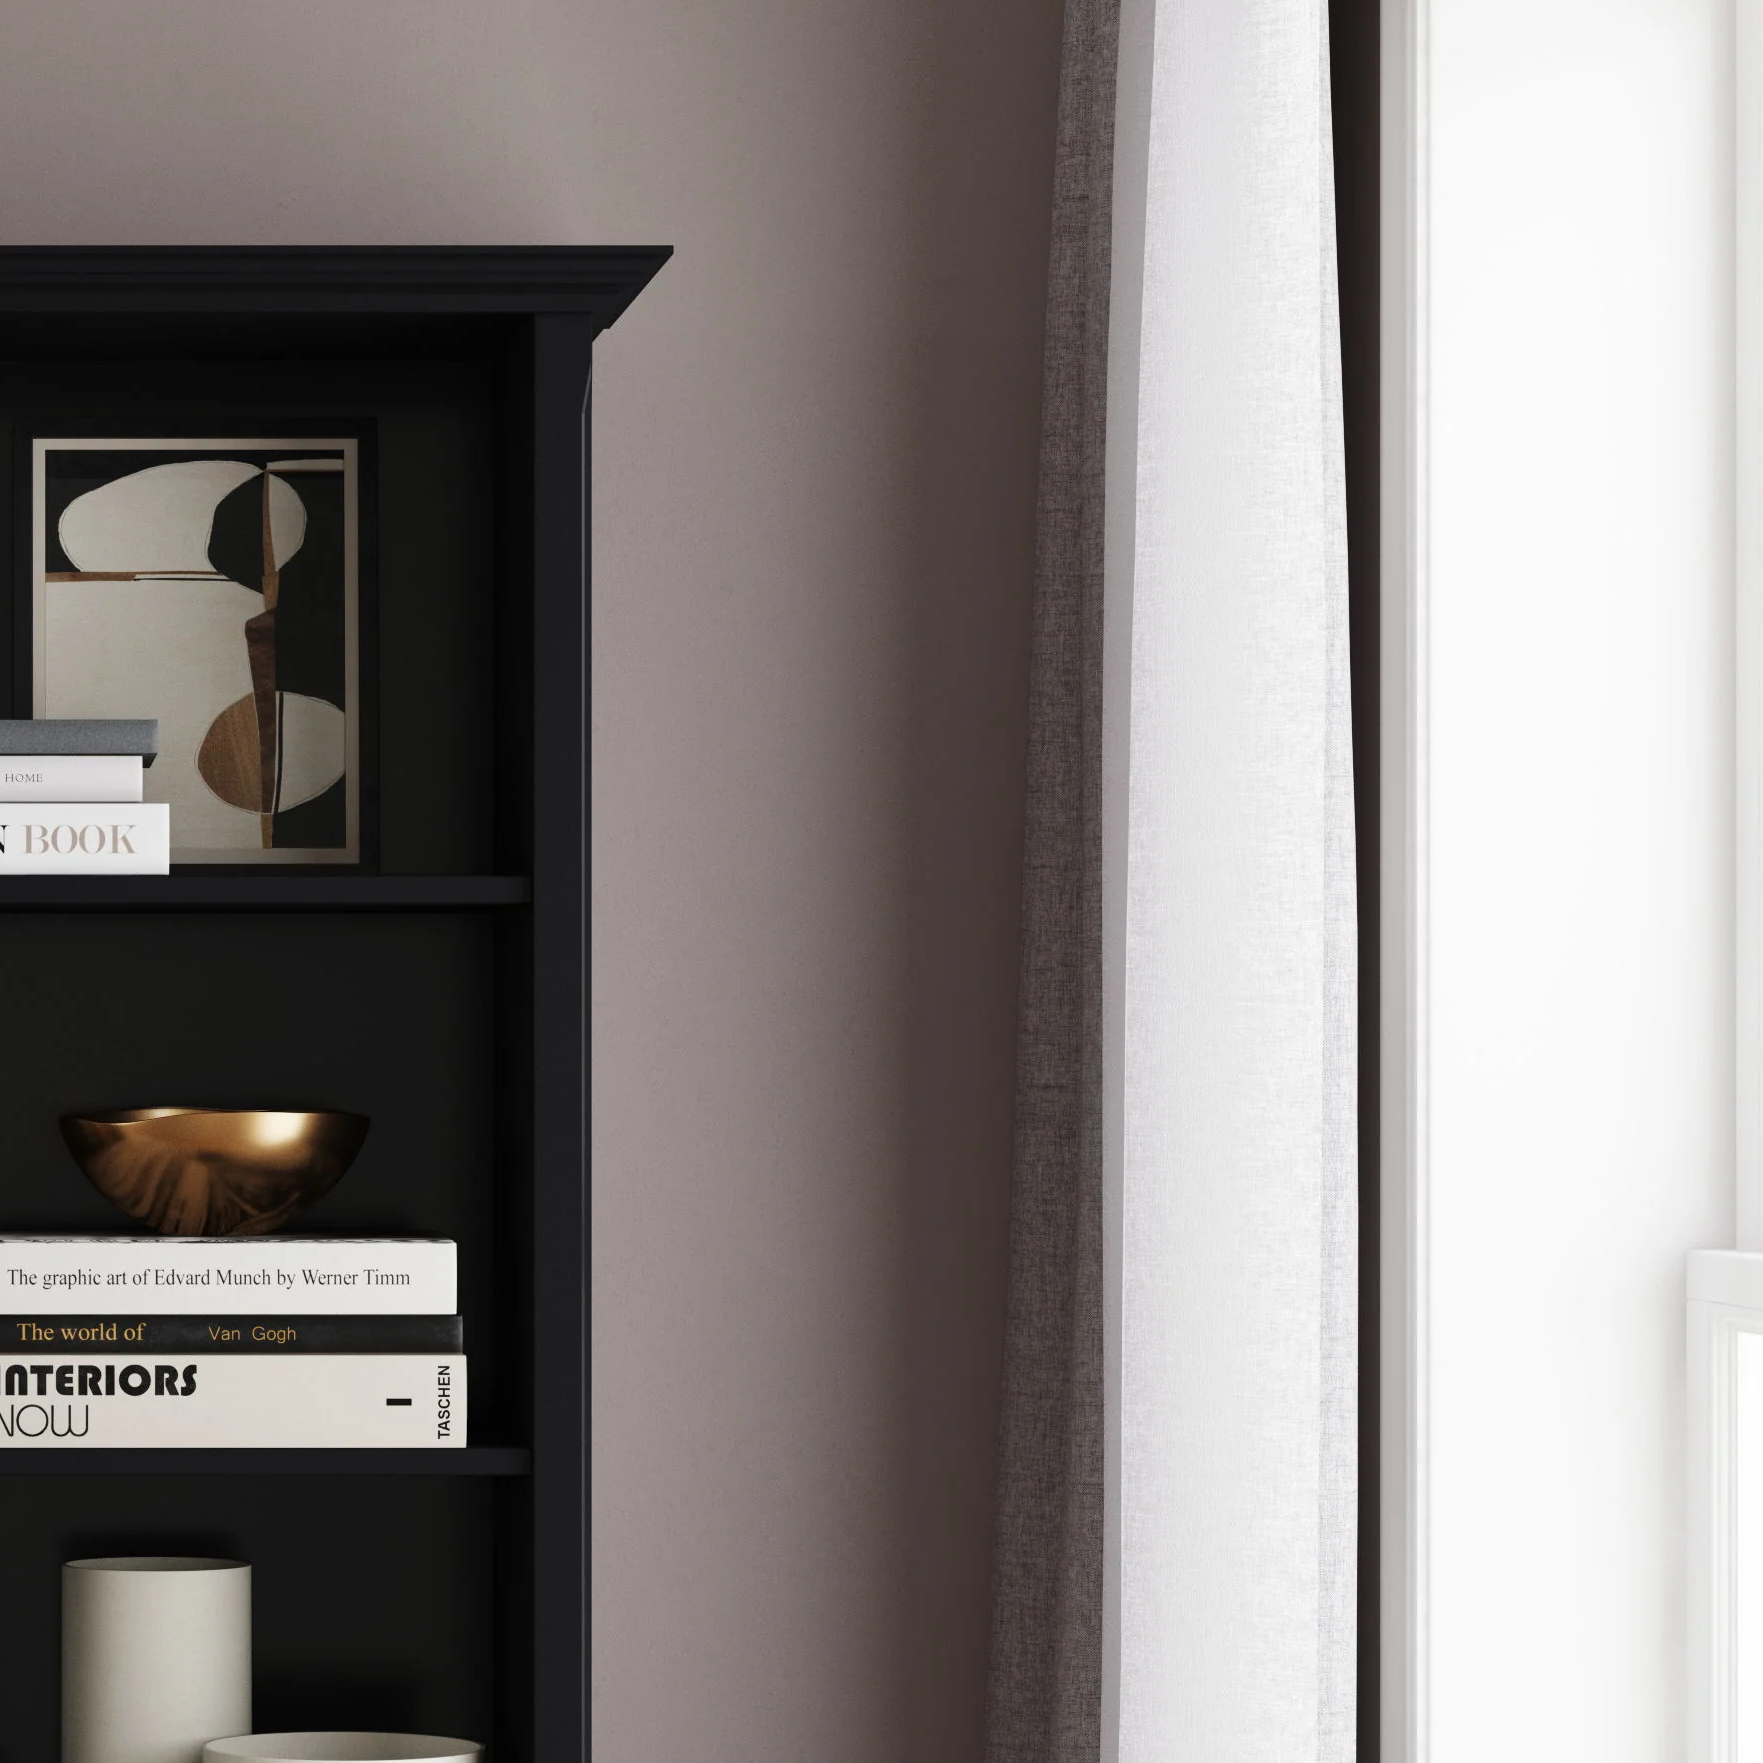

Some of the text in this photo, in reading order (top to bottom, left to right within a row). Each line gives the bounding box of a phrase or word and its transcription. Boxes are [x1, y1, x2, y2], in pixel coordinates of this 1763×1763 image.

[4, 773, 43, 783] HOME
[24, 824, 136, 854] BOOK
[6, 1268, 410, 1290] The graphic art of Edvard Munch by Werner Timm
[16, 1322, 147, 1341] The world of
[208, 1325, 297, 1344] Van Gogh
[437, 1365, 451, 1440] TASCHEN
